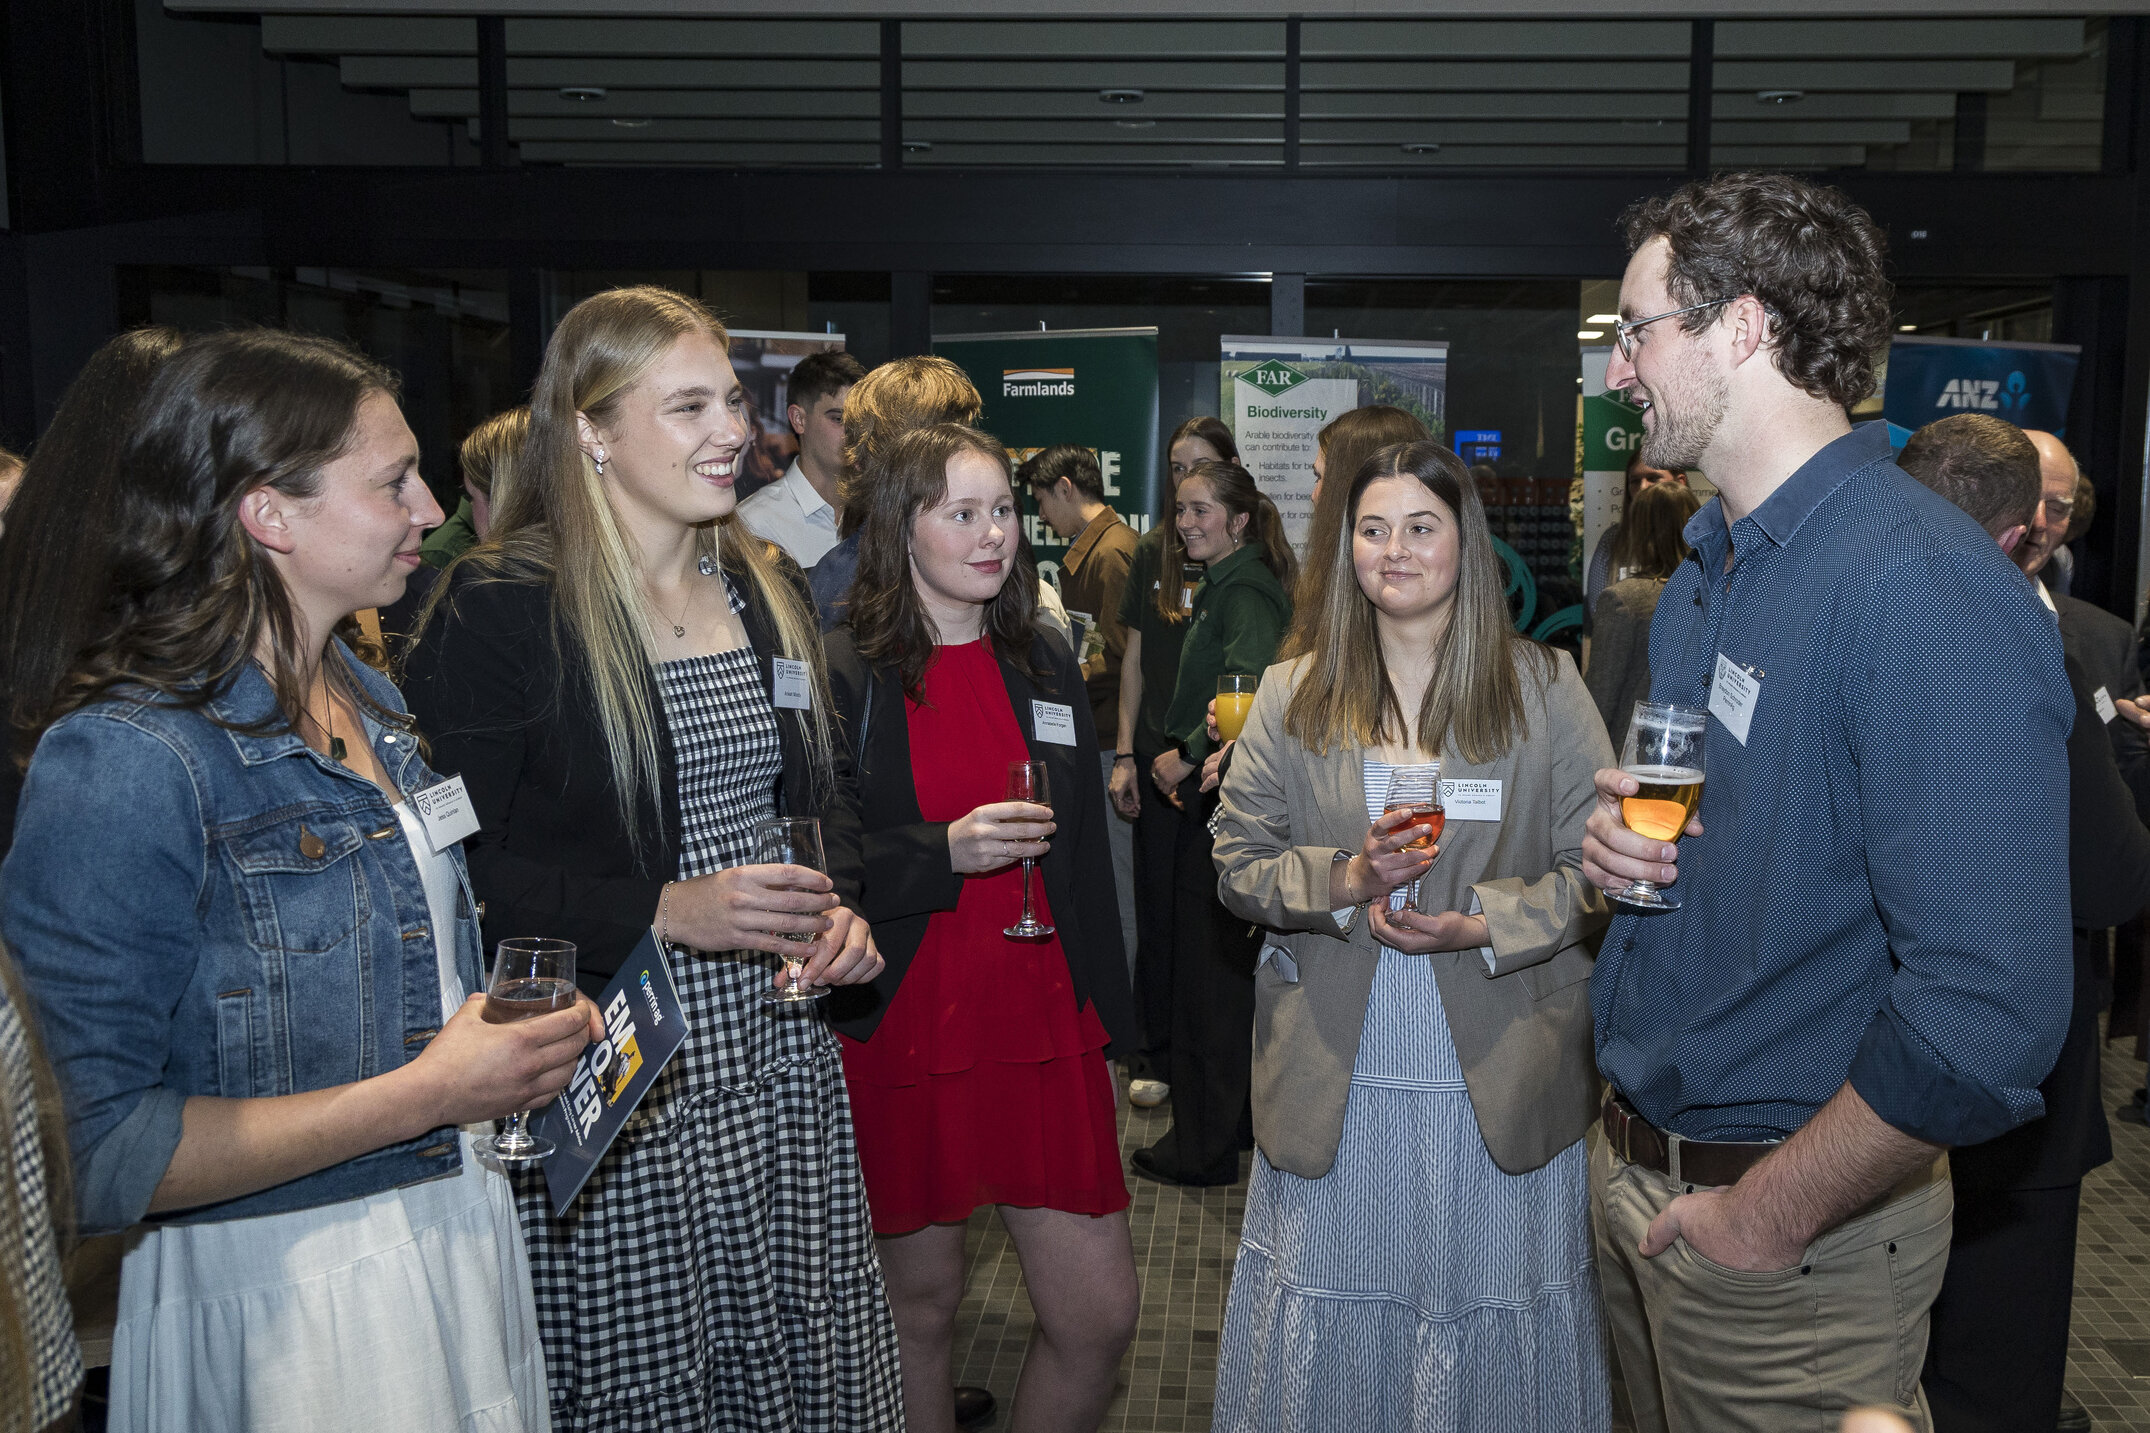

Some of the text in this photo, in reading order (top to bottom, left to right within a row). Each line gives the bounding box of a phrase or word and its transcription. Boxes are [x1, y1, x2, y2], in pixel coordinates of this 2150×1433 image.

[1256, 370, 1293, 385] FAR
[1003, 381, 1075, 397] Farmlands
[1936, 379, 2000, 409] ANZ
[1247, 405, 1328, 421] Biodiversity
[1245, 431, 1315, 442] Arable biodiversity
[1262, 443, 1300, 451] contribute
[1259, 461, 1290, 470] Habitats
[1291, 461, 1303, 470] for
[1284, 491, 1294, 501] for
[1287, 510, 1298, 519] for
[1728, 667, 1745, 683] LINCOLN
[1727, 673, 1751, 695] UNIVERSITY
[429, 784, 452, 798] LINCOLN
[432, 787, 463, 804] UNIVERSITY
[604, 988, 636, 1056] EM
